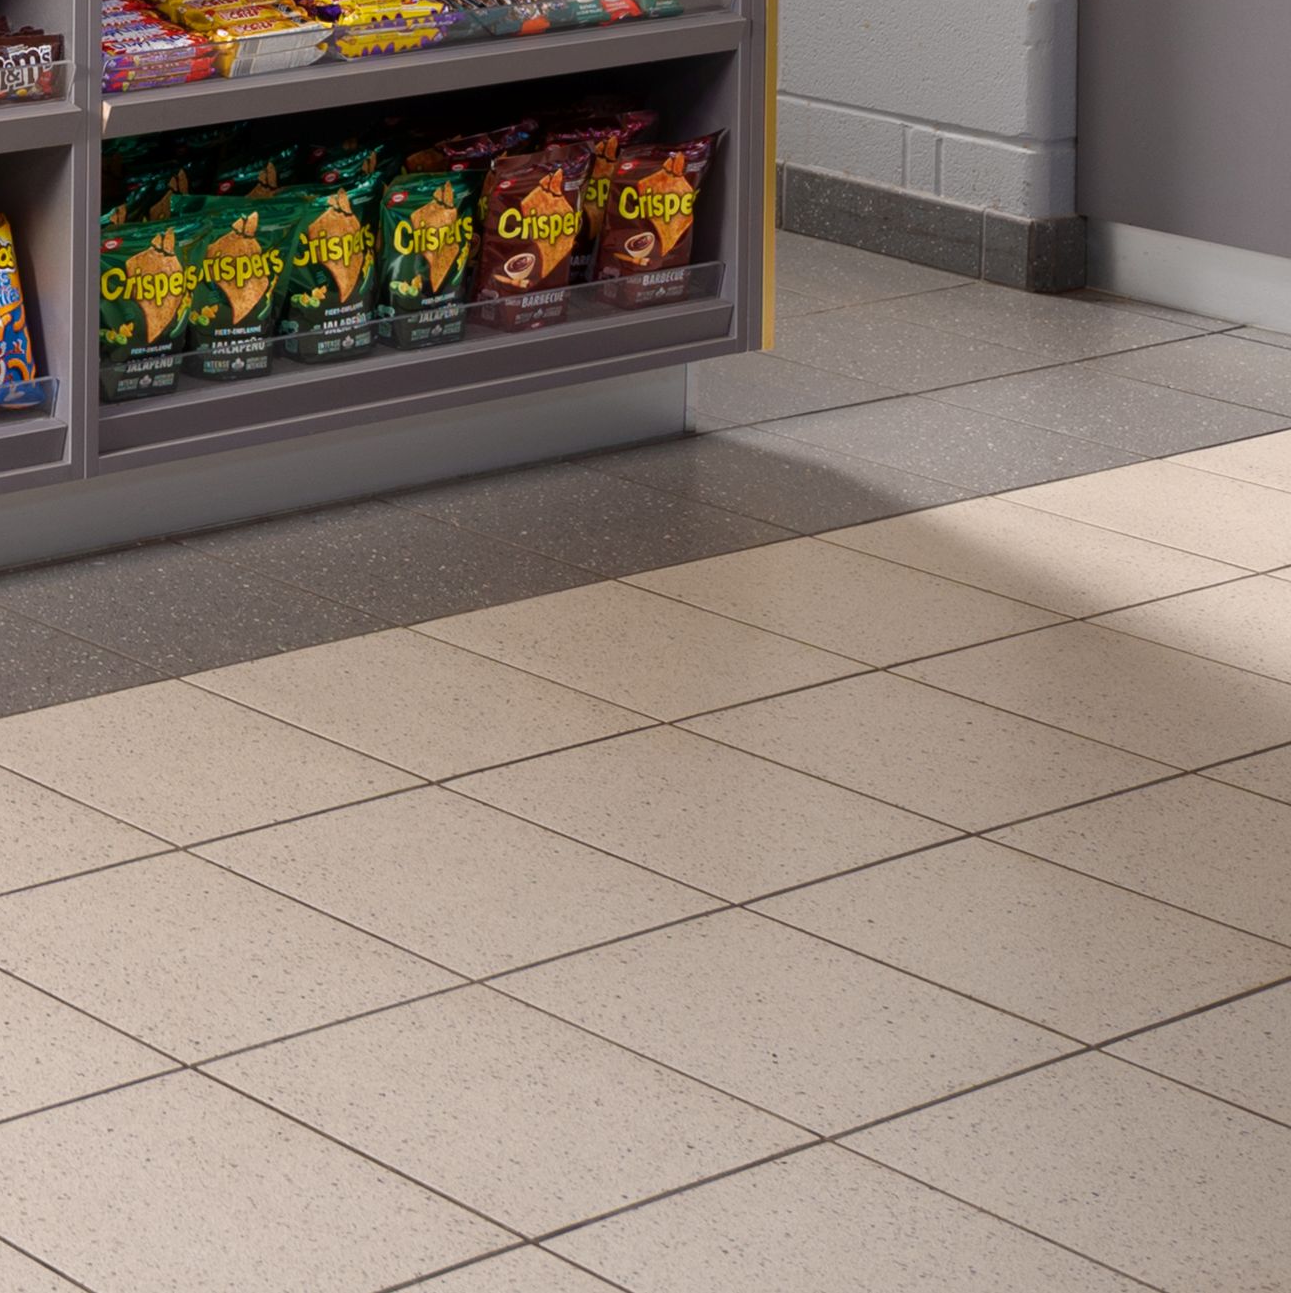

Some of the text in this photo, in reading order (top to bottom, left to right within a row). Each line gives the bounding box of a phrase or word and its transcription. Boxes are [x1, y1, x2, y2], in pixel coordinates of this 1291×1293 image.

[292, 224, 376, 268] Crispers
[392, 214, 474, 256] Crispers
[498, 207, 583, 245] Crisper
[100, 264, 198, 306] Crispers
[642, 268, 685, 288] BARBECUE
[521, 290, 565, 309] BARBECUE
